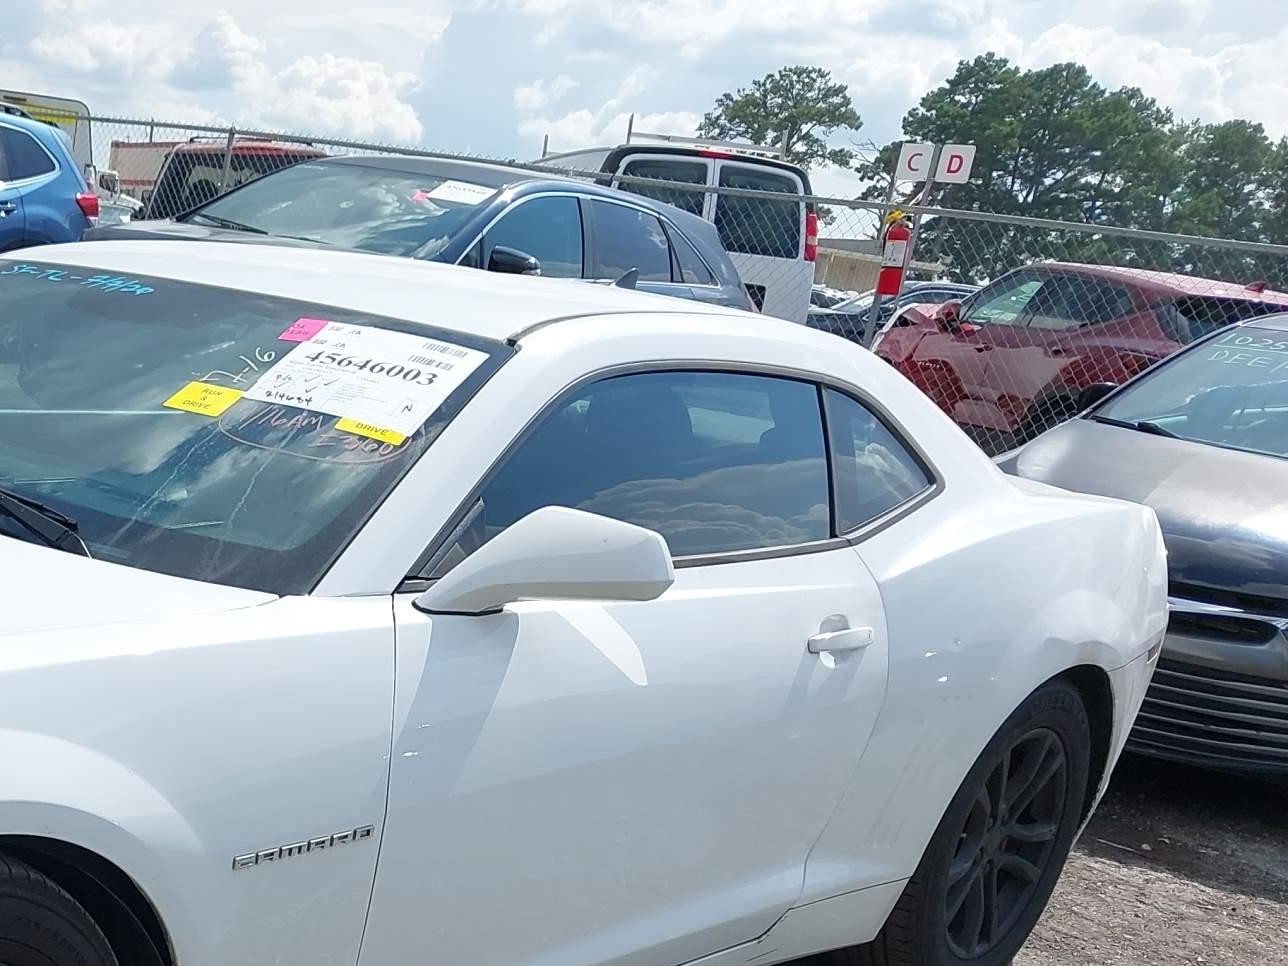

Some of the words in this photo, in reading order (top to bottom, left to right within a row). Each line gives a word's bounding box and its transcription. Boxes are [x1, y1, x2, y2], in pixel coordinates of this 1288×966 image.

[907, 152, 924, 172] C
[946, 154, 964, 174] D
[305, 349, 439, 388] 45646003
[182, 399, 212, 410] DRIVE
[355, 422, 390, 436] DRIVE
[231, 824, 375, 870] CAMARO
